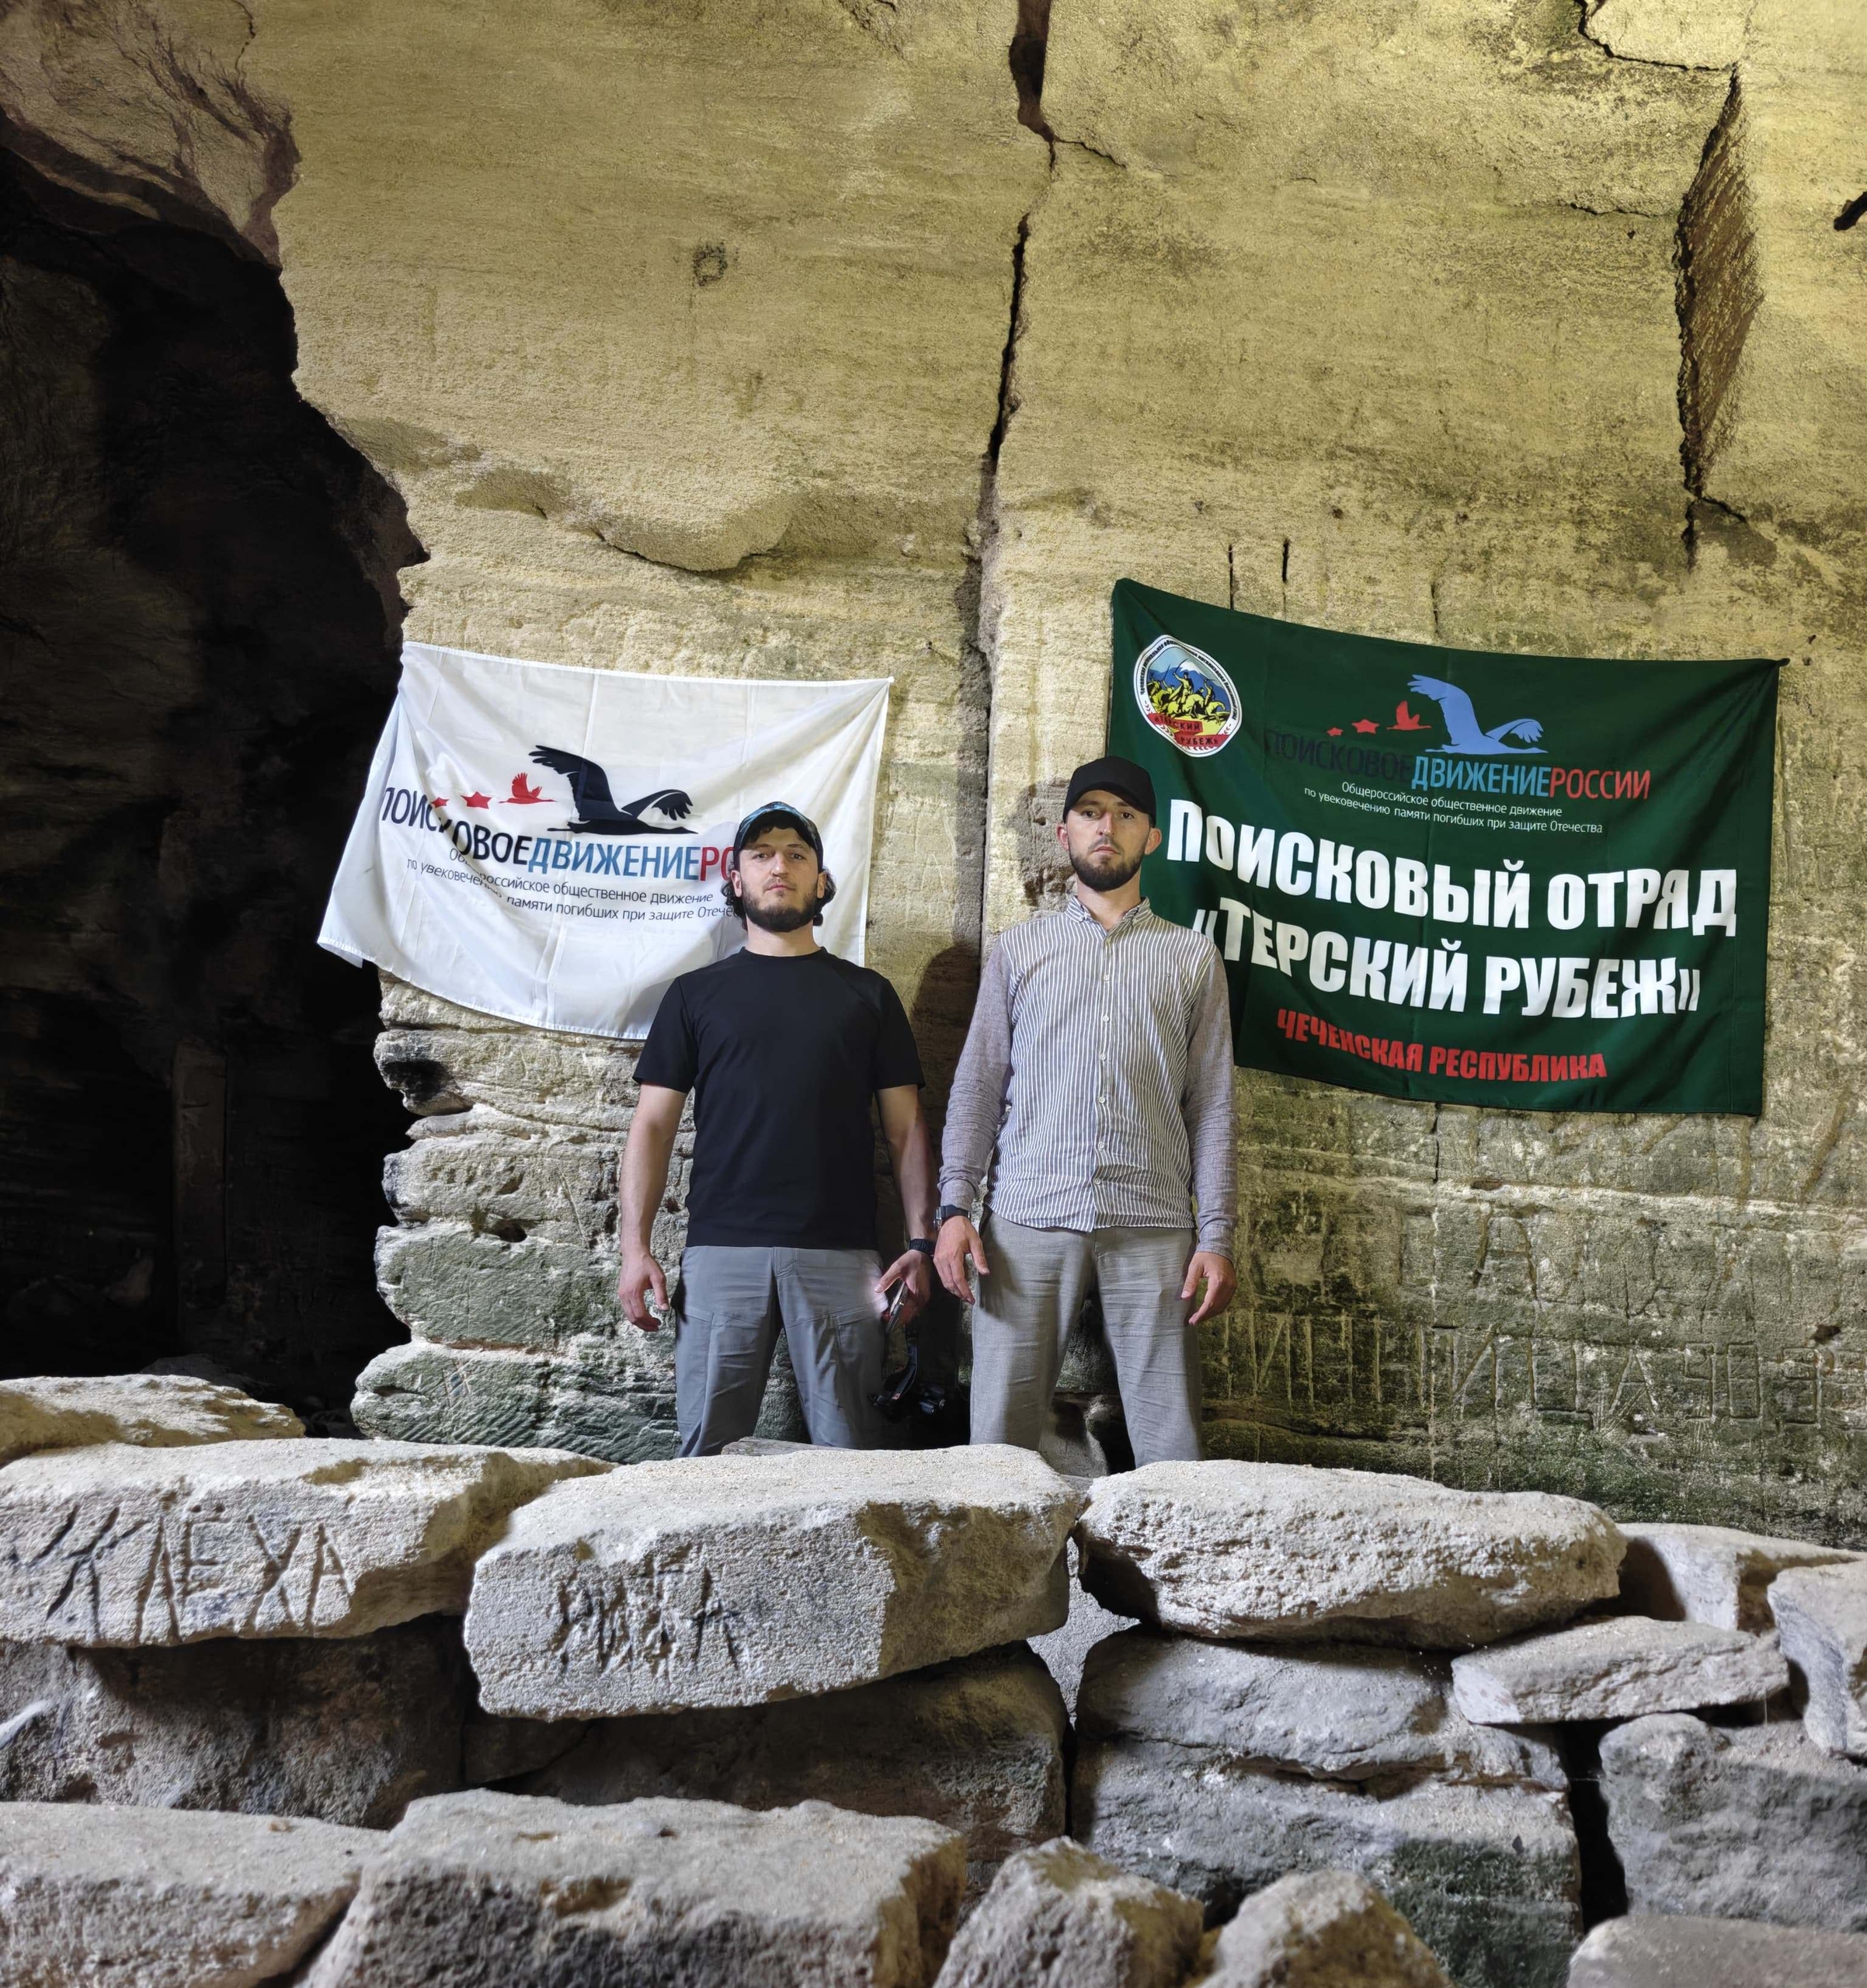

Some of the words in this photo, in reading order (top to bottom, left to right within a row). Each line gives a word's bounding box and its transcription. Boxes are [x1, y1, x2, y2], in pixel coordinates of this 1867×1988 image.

[1304, 787, 1316, 798] по
[1319, 791, 1390, 815] увековечению
[1394, 807, 1431, 821] памяти
[1433, 813, 1485, 827] погибших
[1487, 818, 1506, 830] при
[1508, 821, 1548, 832] защите
[1550, 820, 1603, 833] Отечества
[1341, 781, 1429, 806] Общероссийское
[1431, 797, 1507, 814] общественное
[1509, 805, 1563, 817] движение
[407, 858, 418, 870] по
[506, 896, 553, 912] памяти
[556, 903, 619, 919] погибших
[622, 909, 645, 920] при
[648, 911, 694, 923] защите
[697, 905, 735, 918] Отече
[554, 881, 647, 902] общественное
[650, 892, 714, 905] движение
[1547, 867, 1737, 937] ОТРЯД
[1277, 1007, 1424, 1072] ЧЕЧЕНСКАЯ
[1428, 1046, 1608, 1082] РЕСПУБЛИКА
